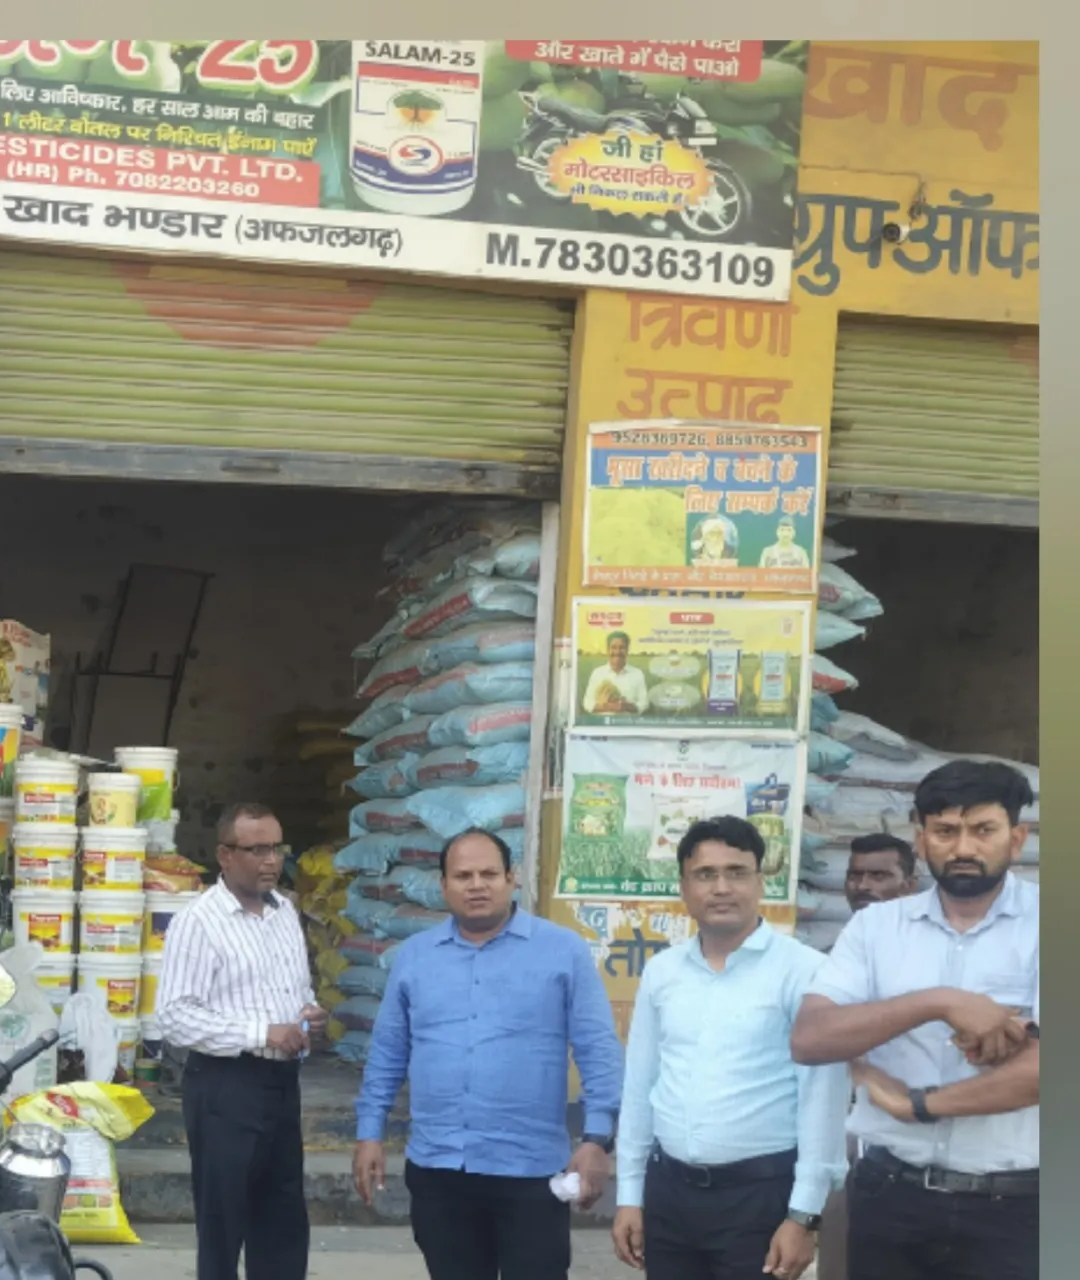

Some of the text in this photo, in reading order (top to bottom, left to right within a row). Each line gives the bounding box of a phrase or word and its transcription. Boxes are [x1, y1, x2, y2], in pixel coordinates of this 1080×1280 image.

[365, 41, 476, 67] SALAM-25
[535, 41, 739, 77] और खाते में पैसे पाओ
[0, 79, 35, 103] लिए
[132, 96, 156, 115] हर
[161, 99, 200, 117] साल
[203, 104, 240, 121] आम
[244, 103, 268, 125] की
[601, 135, 632, 158] जी
[7, 159, 59, 183] (HR)
[68, 165, 106, 186] Ph.
[115, 169, 260, 197] 7082203260
[167, 153, 229, 176] PVT.
[240, 159, 303, 183] LTD.
[563, 157, 696, 190] मोटरसाइकिल
[2, 192, 405, 259] खाद भण्डार (अफजलगढ़)
[486, 231, 777, 289] M.7830363109
